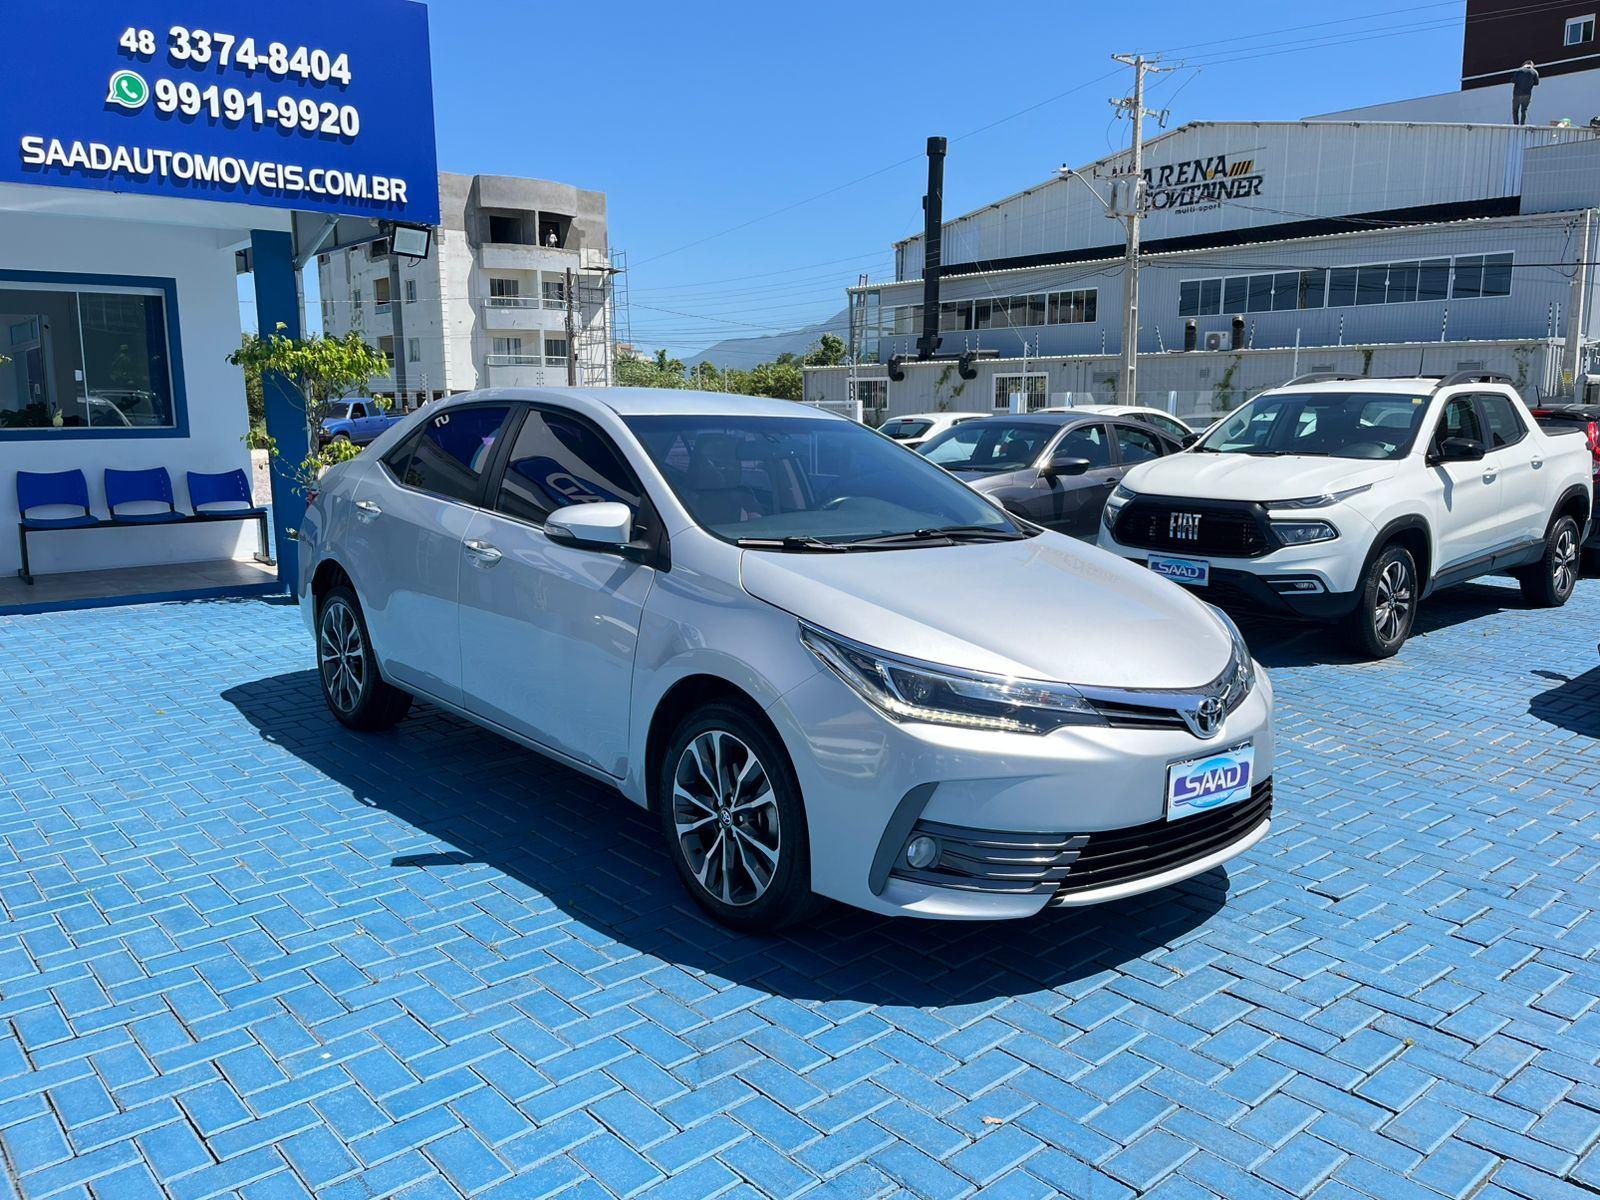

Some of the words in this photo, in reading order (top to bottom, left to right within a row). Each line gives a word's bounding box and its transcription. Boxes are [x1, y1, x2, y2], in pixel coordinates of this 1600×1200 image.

[119, 27, 156, 55] 48
[169, 26, 351, 85] 3374-8404
[155, 79, 360, 137] 99191-9920
[21, 136, 408, 203] SAADAUTOMOVEIS.COM.BR
[1142, 155, 1228, 189] ARENA
[1174, 202, 1222, 215] multi-sport
[1169, 512, 1202, 540] FIAT
[1158, 563, 1199, 577] SAAD
[1185, 766, 1241, 797] SAAD
